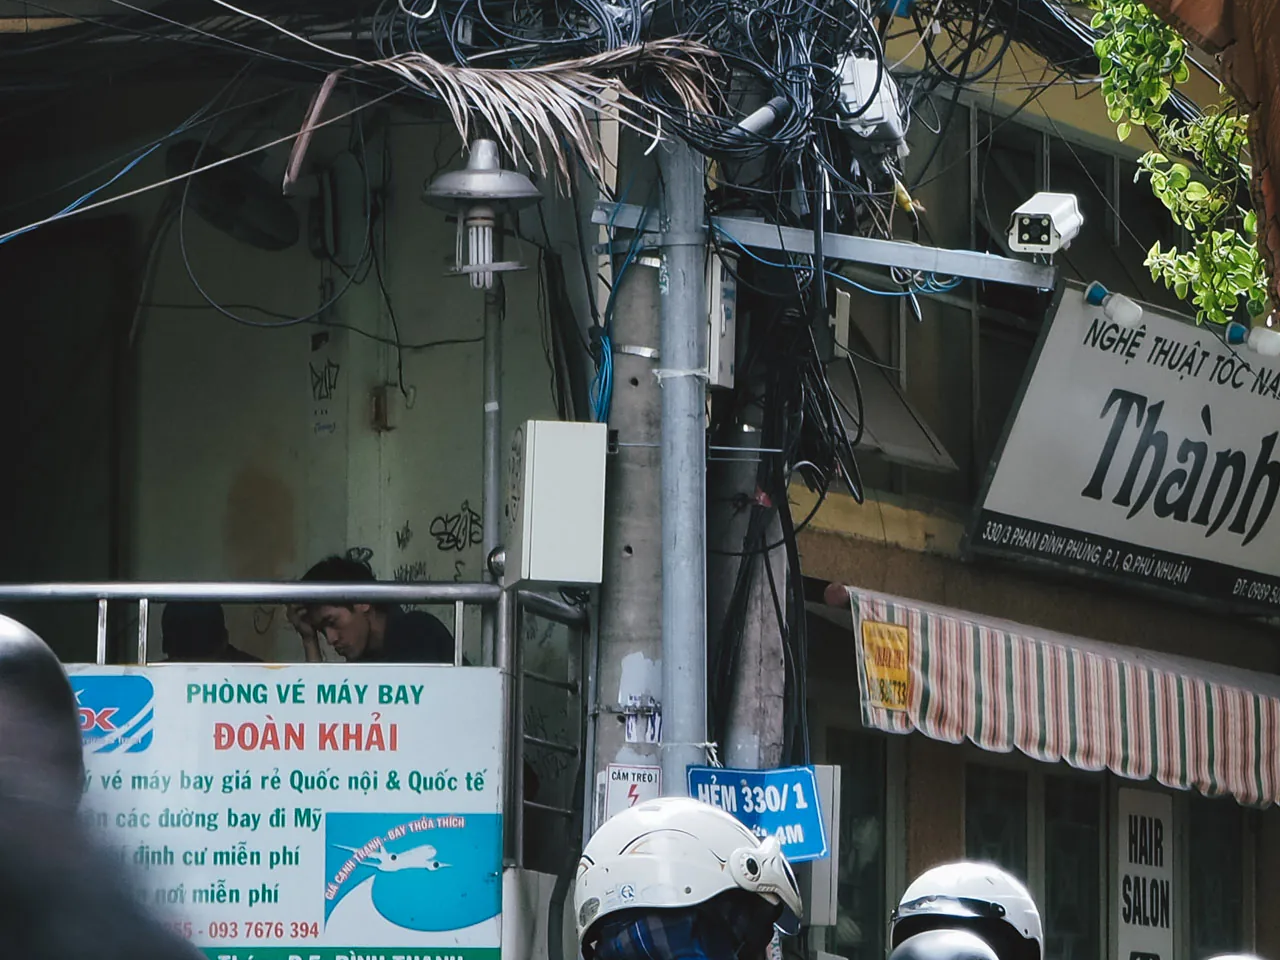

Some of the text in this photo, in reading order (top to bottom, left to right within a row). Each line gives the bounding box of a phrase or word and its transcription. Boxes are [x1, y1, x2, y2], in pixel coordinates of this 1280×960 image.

[1083, 318, 1147, 365] NGHỆ
[1147, 335, 1210, 381] THUẬT
[982, 520, 1011, 546] 330/3
[1010, 526, 1040, 551] PHAN
[1038, 530, 1067, 554] ĐÌNH
[1154, 559, 1192, 585] NHUẬN
[187, 678, 424, 705] PHÒNG VÉ MÁY BAY
[213, 711, 398, 751] ĐOÀN KHẢI
[101, 770, 122, 790] vé
[131, 770, 171, 794] máy
[181, 770, 214, 794] bay
[222, 770, 252, 794] giá
[260, 767, 281, 790] rẻ
[290, 768, 340, 794] Quốc
[348, 771, 378, 795] nội
[386, 771, 401, 791] &
[408, 768, 458, 794] Quốc
[465, 768, 488, 791] tế
[698, 774, 808, 814] HẺM 330/1
[115, 808, 151, 828] các
[158, 807, 219, 832] đường
[227, 808, 261, 831] bay
[269, 807, 286, 828] đi
[294, 807, 322, 832] Mỹ
[133, 844, 174, 870] định
[182, 847, 208, 866] cư
[213, 841, 261, 866] miễn
[269, 845, 300, 870] phí
[325, 882, 339, 901] GIÁ
[334, 859, 356, 884] CẠNH
[353, 835, 383, 863] TRANH
[387, 825, 407, 841] BAY
[408, 816, 435, 832] THỎA
[436, 815, 466, 829] THÍCH
[1128, 814, 1164, 868] HAIR
[193, 879, 240, 904] miễn
[248, 883, 279, 907] phí
[1122, 874, 1170, 929] SALON
[208, 921, 239, 939] 093
[244, 921, 284, 939] 7676
[289, 921, 320, 939] 394
